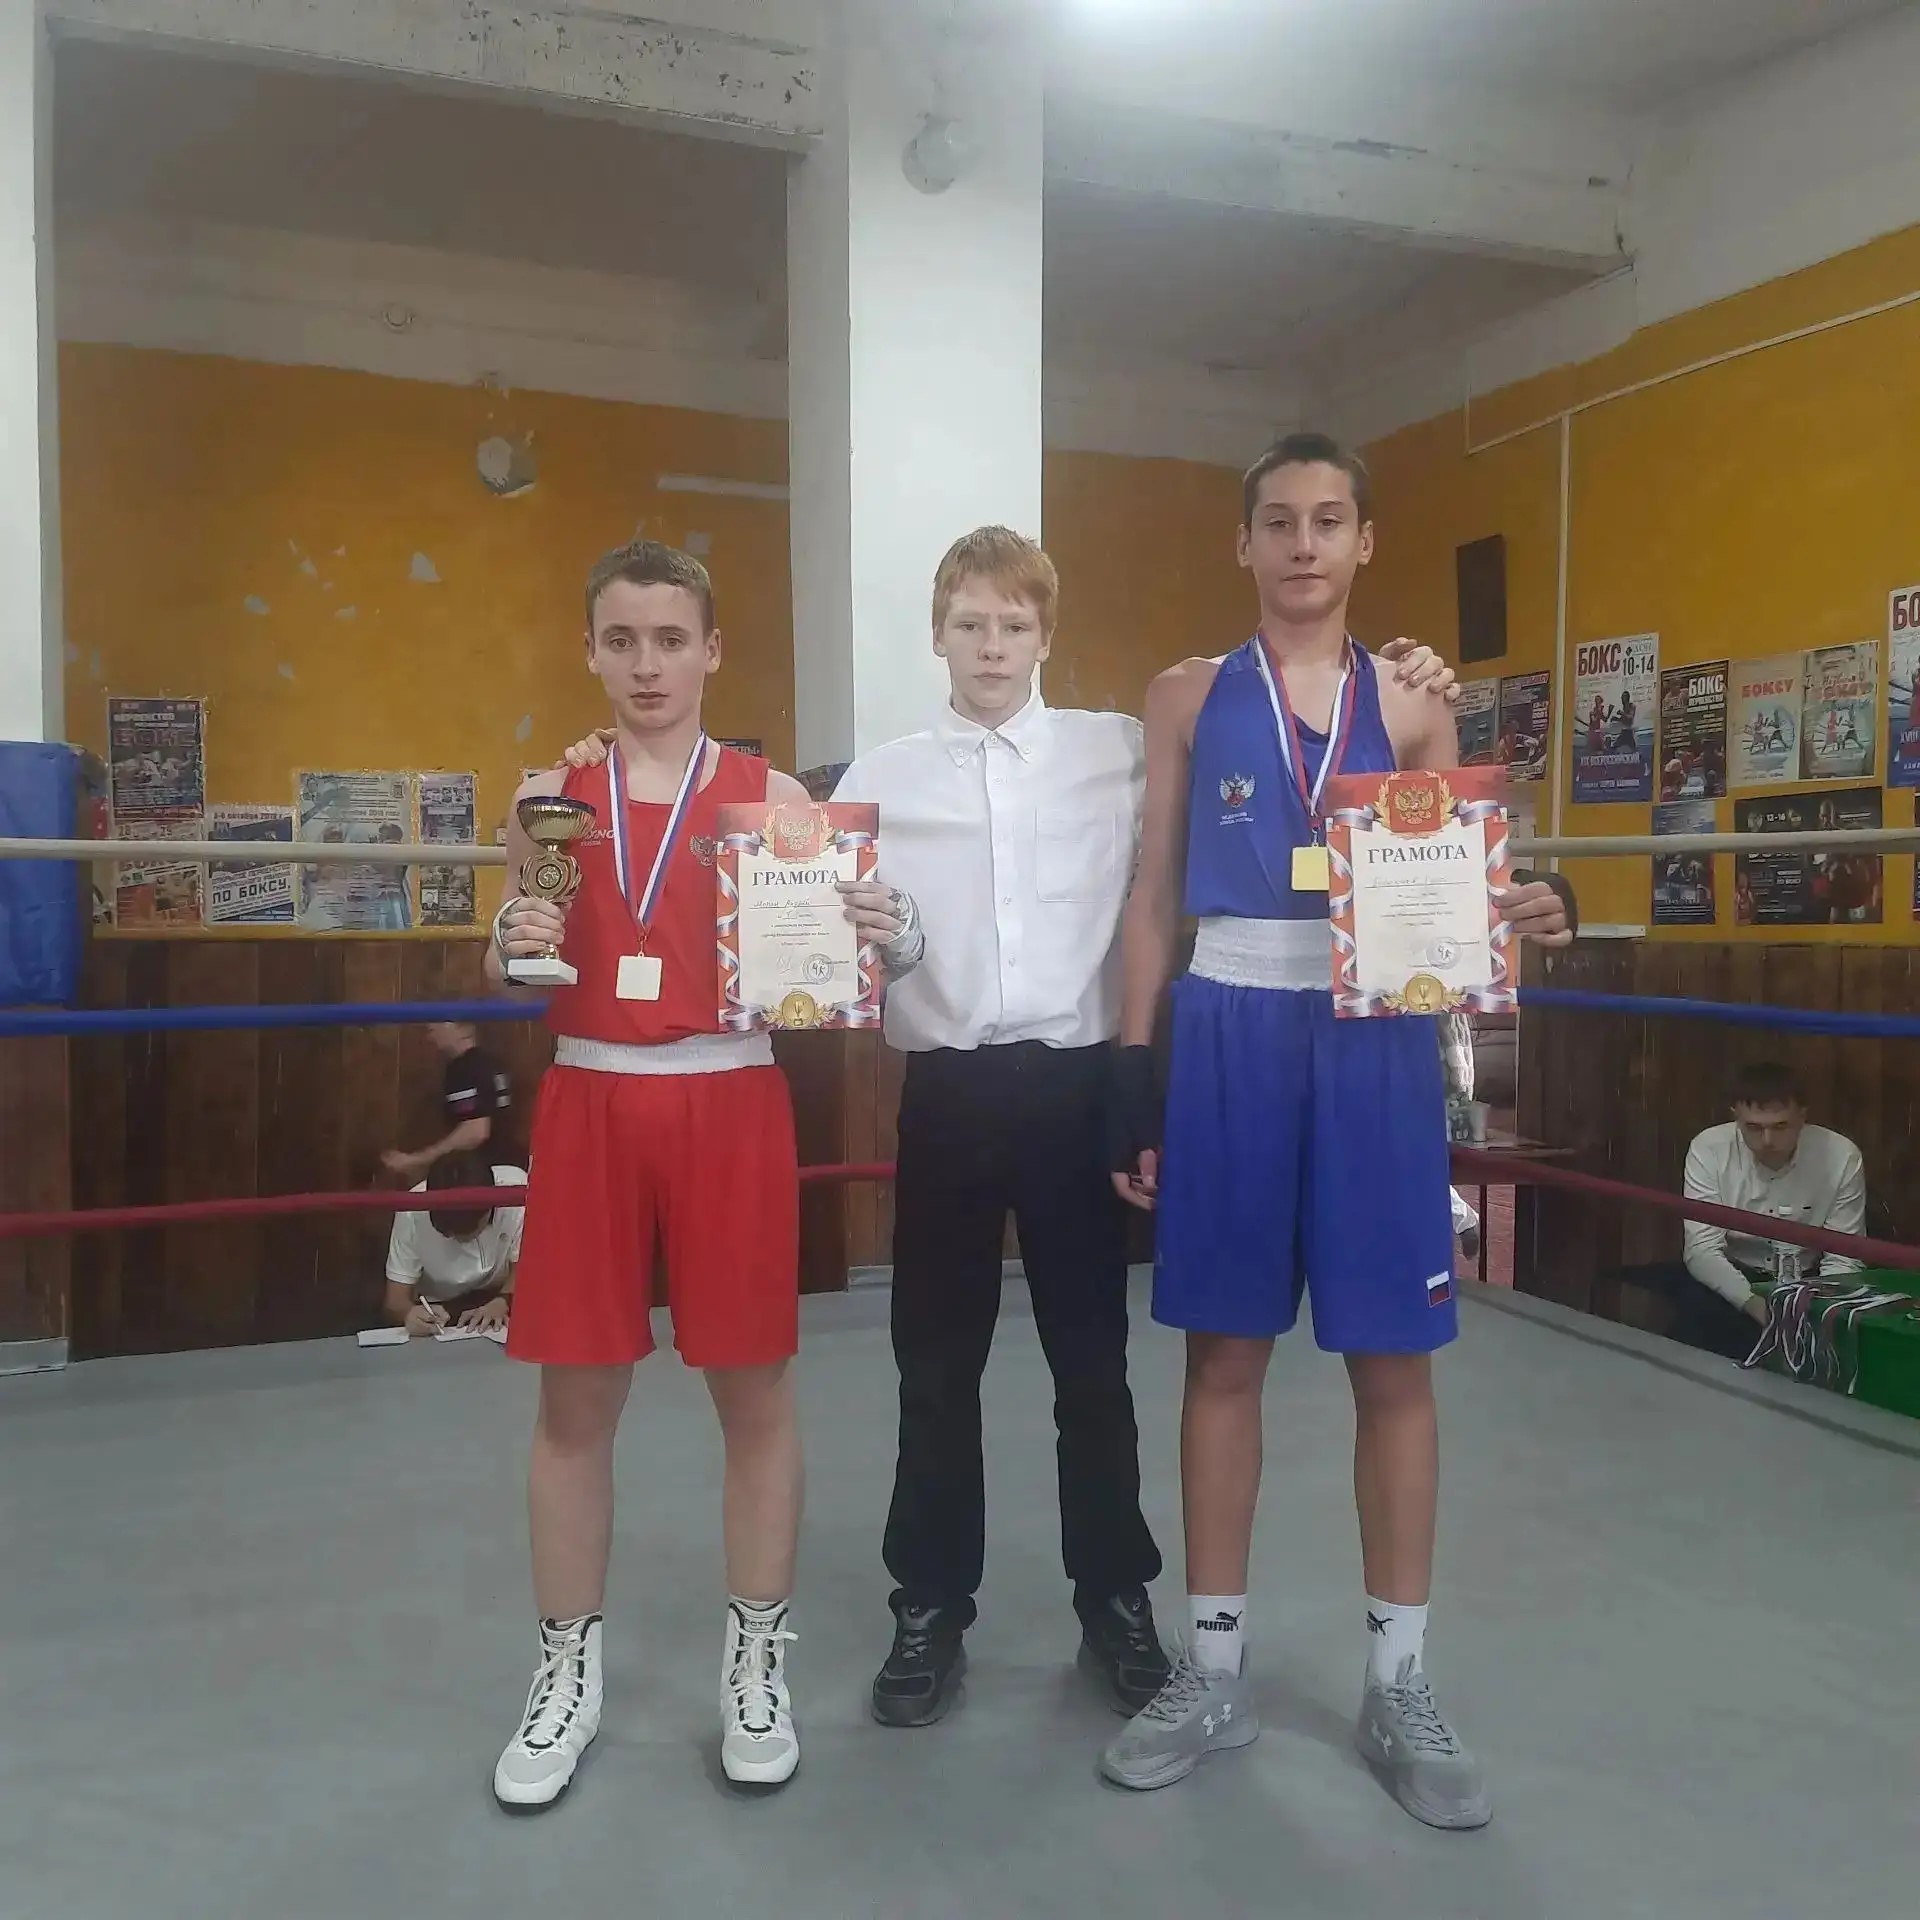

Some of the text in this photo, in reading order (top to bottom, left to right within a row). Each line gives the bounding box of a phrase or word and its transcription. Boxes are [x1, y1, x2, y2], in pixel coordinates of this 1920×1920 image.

[1578, 643, 1621, 676] БОКС
[1688, 674, 1724, 697] БОКС
[1368, 843, 1468, 864] ГРАМОТА
[752, 869, 840, 886] ГРАМОТА
[213, 890, 231, 904] ПО
[239, 878, 291, 898] БОКСУ.
[1196, 1619, 1234, 1632] PUMA
